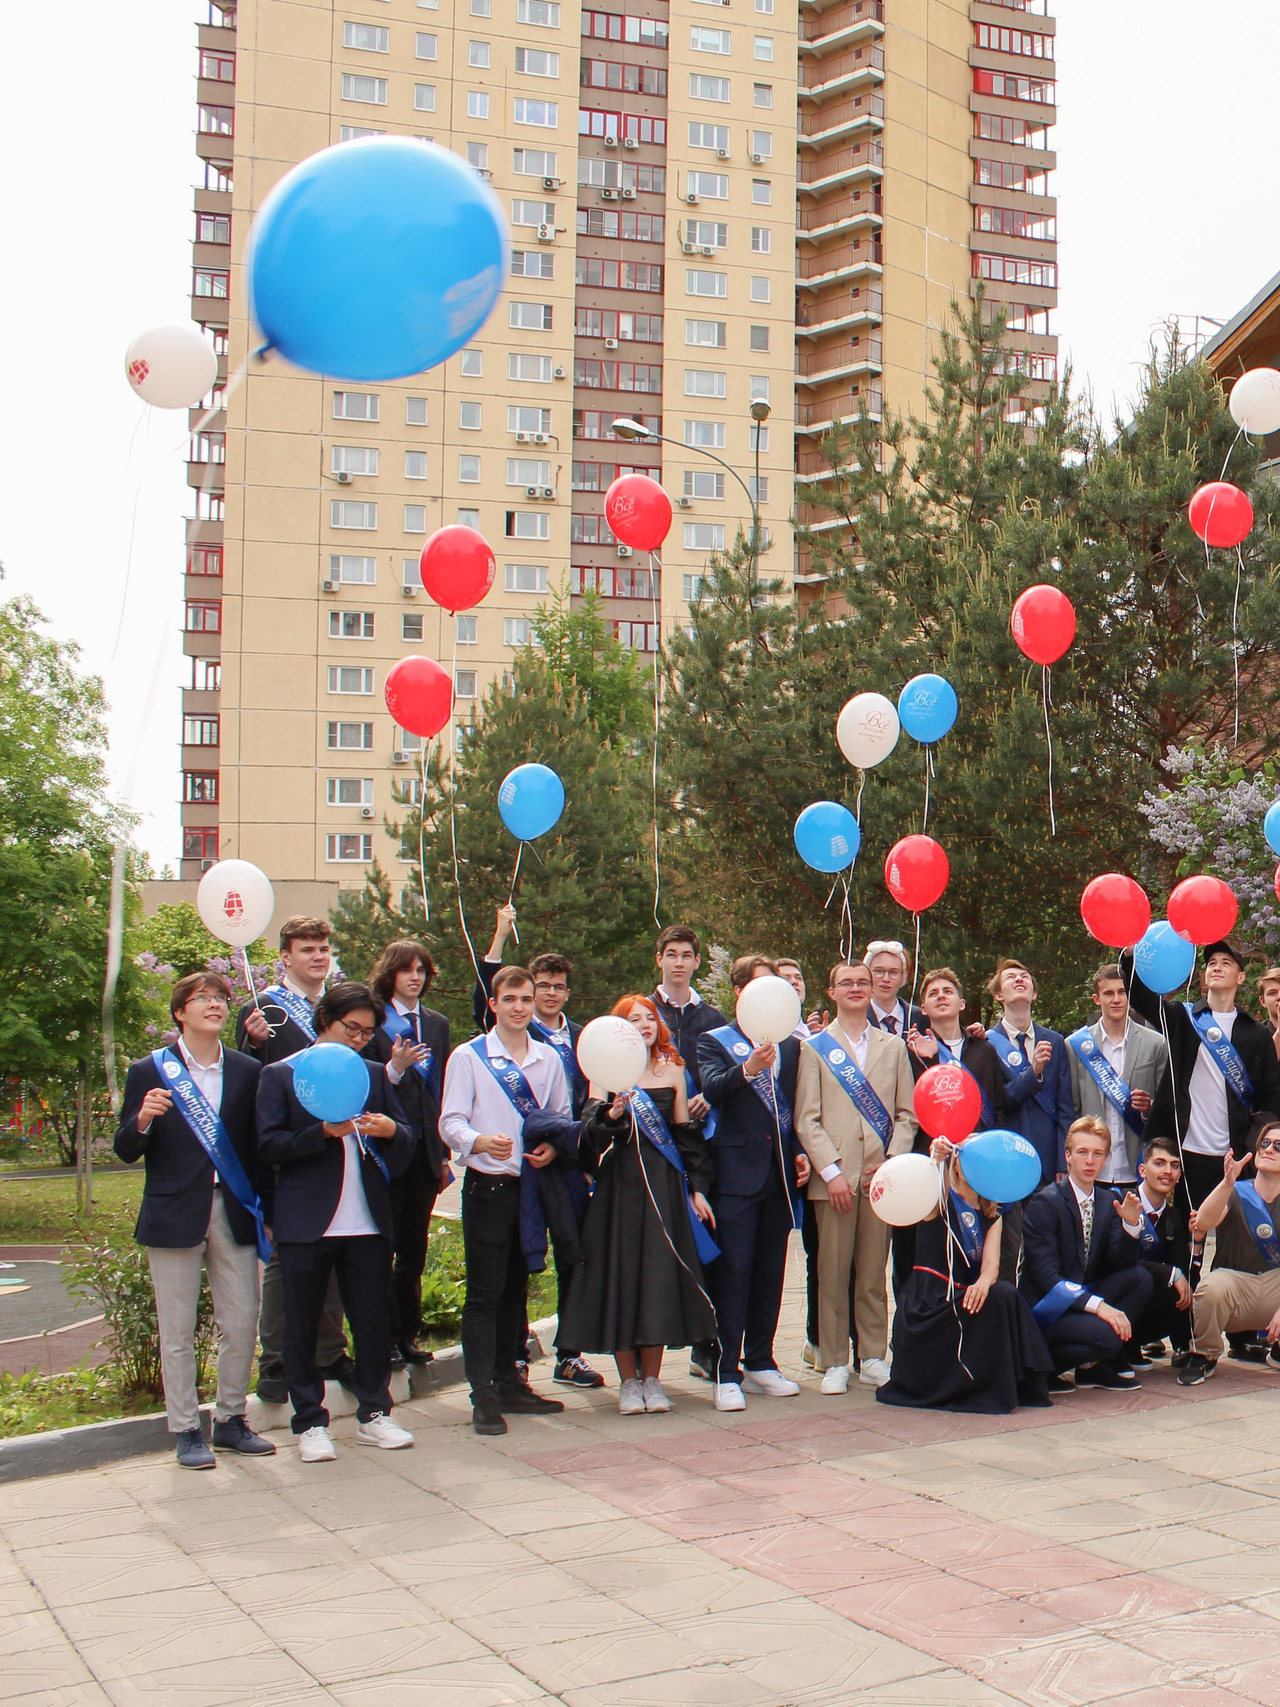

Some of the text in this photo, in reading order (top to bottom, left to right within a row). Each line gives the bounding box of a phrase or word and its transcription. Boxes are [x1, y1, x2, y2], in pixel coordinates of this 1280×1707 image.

[908, 690, 938, 707] Всё
[858, 710, 892, 730] Всё
[1134, 940, 1158, 960] Всё
[1215, 1044, 1247, 1095] Выпускни
[294, 1079, 316, 1098] Всё
[929, 1074, 962, 1095] Всё
[1088, 1055, 1130, 1106] Выпускник
[839, 1065, 883, 1121] Выпускник
[174, 1080, 220, 1146] Выпускник
